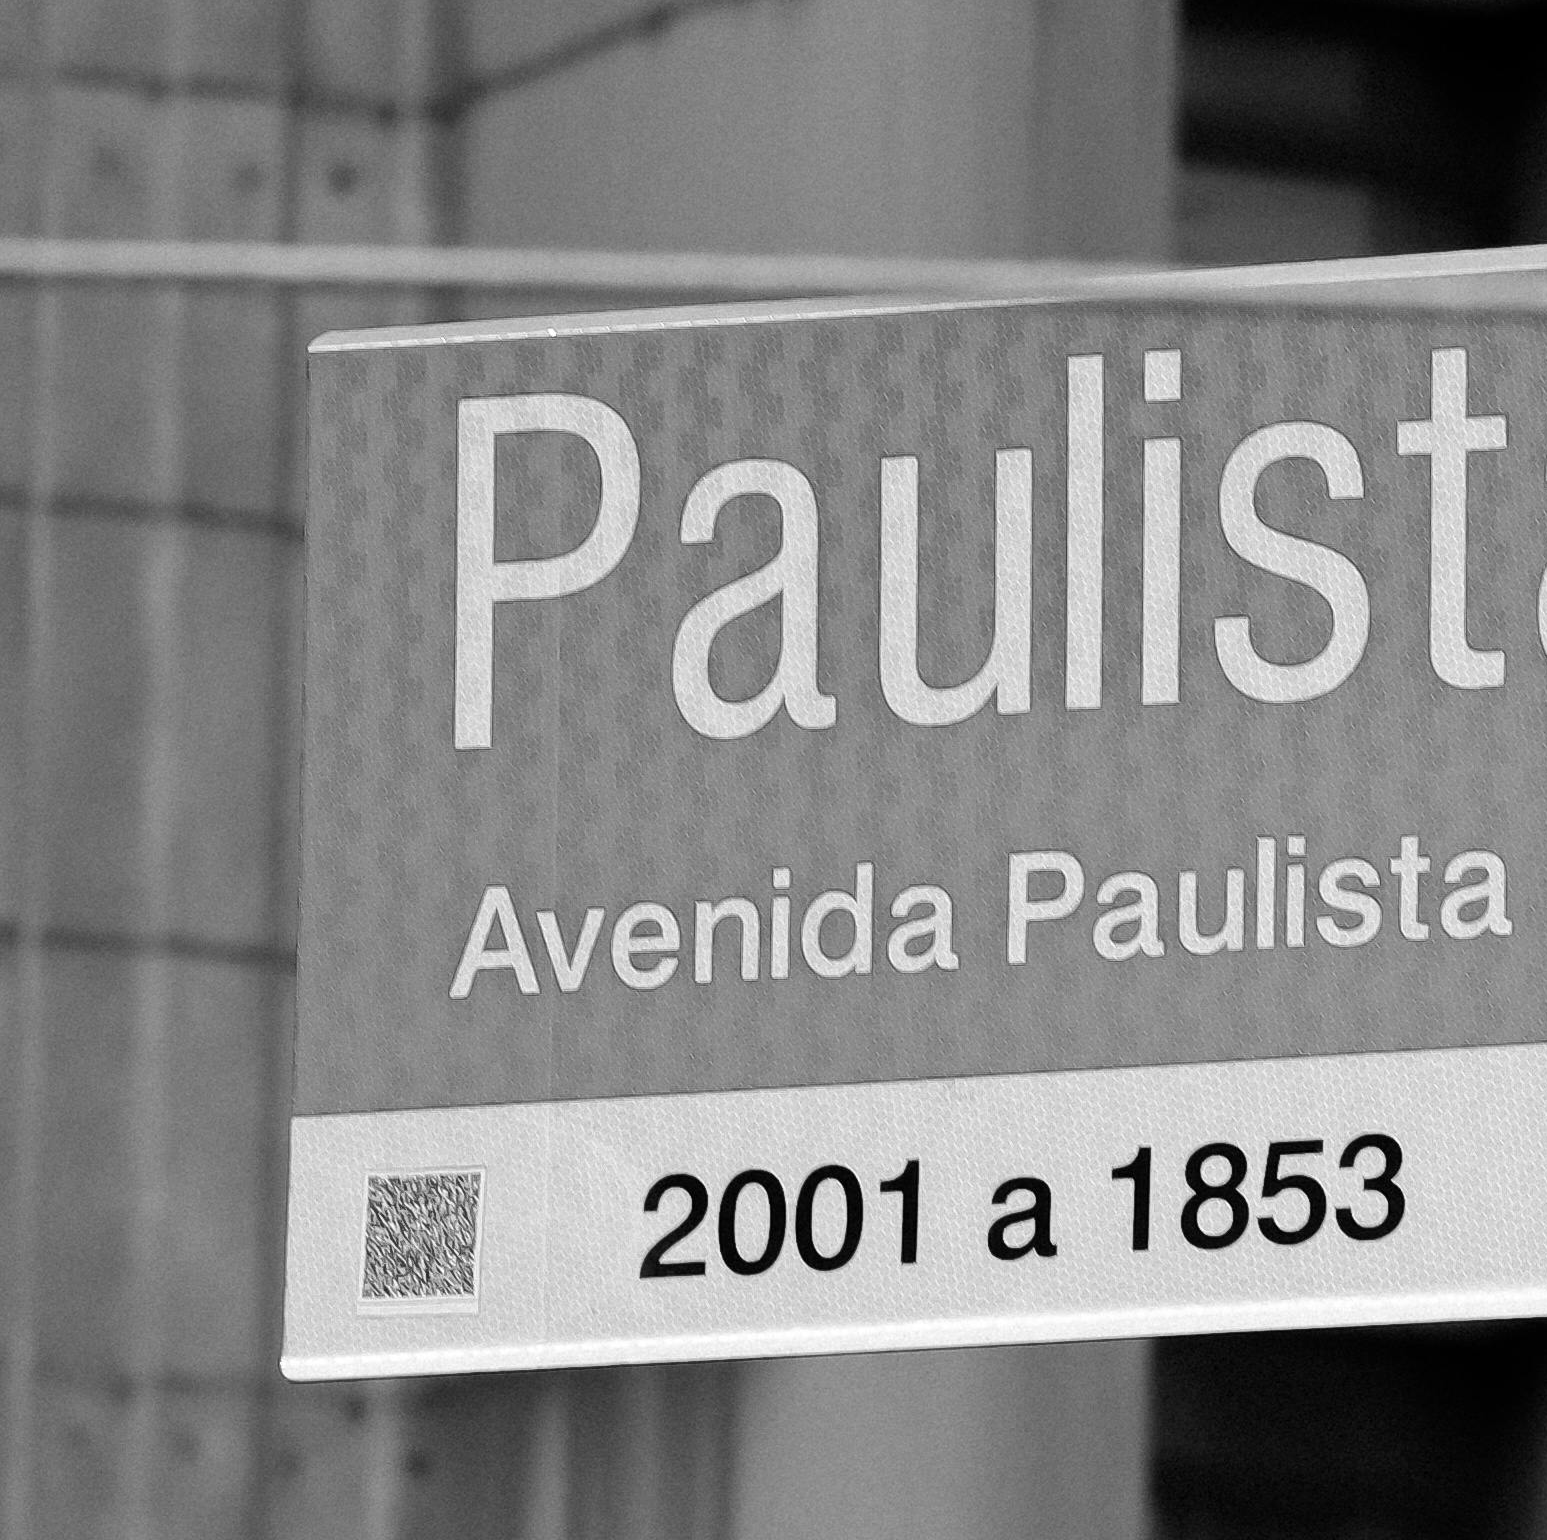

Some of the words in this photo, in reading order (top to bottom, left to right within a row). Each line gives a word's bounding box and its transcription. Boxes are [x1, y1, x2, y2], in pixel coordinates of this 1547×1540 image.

[449, 862, 960, 999] Avenida
[1006, 835, 1514, 965] Paulista
[639, 1159, 921, 1280] 2001
[986, 1175, 1059, 1262] a
[1111, 1133, 1407, 1253] 1853
